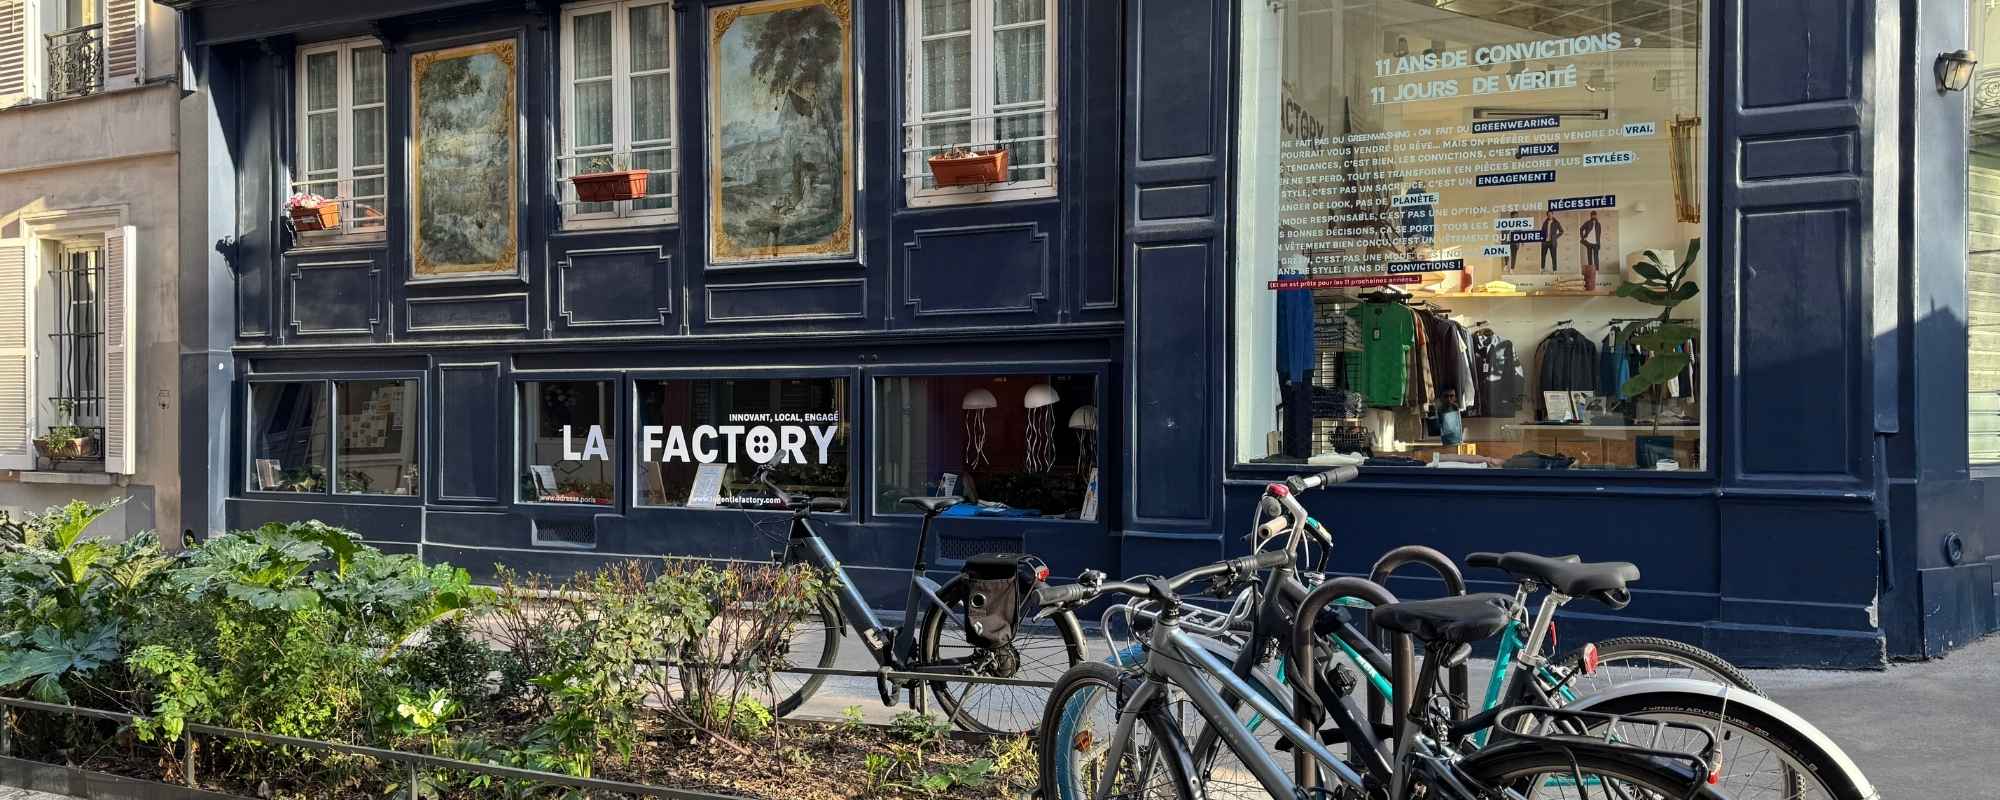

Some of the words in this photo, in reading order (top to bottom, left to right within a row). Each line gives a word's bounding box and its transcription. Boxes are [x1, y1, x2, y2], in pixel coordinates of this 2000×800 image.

[1376, 58, 1391, 77] 11
[1395, 52, 1437, 73] ANS
[1441, 50, 1467, 68] DE
[1475, 31, 1621, 65] CONVICTIONS
[1370, 87, 1384, 104] 11
[1393, 80, 1458, 101] JOURS
[1472, 76, 1499, 94] DE
[1507, 64, 1577, 91] VÉRITÉ
[1281, 149, 1325, 159] POURRAIT
[1327, 147, 1351, 156] VOUS
[1354, 145, 1390, 154] VENDRE
[1393, 144, 1406, 152] DU
[1443, 139, 1468, 149] MAIS
[1471, 138, 1484, 146] ON
[1625, 125, 1654, 134] VRAI.
[1314, 137, 1329, 146] PAS
[1332, 135, 1345, 144] DU
[1456, 124, 1469, 133] DU
[1474, 118, 1558, 132] GREENWEARING.
[1344, 158, 1370, 168] C'EST
[1488, 148, 1518, 157] C'EST
[1521, 145, 1557, 154] MIEUX.
[1312, 187, 1337, 196] C'EST
[1340, 186, 1356, 194] PAS
[1360, 184, 1373, 192] UN
[1478, 172, 1548, 185] ENGAGEMENT
[1347, 171, 1372, 180] TOUT
[1373, 171, 1385, 179] SE
[1282, 217, 1308, 226] MODE
[1408, 209, 1426, 219] PAS
[1429, 208, 1449, 217] UNE
[1550, 196, 1607, 210] NÉCESSITÉ
[1313, 202, 1325, 210] DE
[1355, 198, 1373, 207] PAS
[1375, 197, 1389, 206] DE
[1287, 229, 1323, 238] BONNES
[1396, 225, 1407, 233] SE
[1409, 223, 1440, 233] PORTE
[1496, 220, 1532, 229] JOURS.
[1285, 240, 1331, 250] VÊTEMENT
[1333, 239, 1354, 248] BIEN
[1513, 232, 1544, 241] DURE.
[1316, 255, 1341, 263] C'EST
[1343, 254, 1360, 262] PAS
[1363, 253, 1382, 261] UNE
[1484, 247, 1508, 256] ADN.
[1352, 264, 1371, 273] ANS
[1375, 263, 1388, 272] DE
[1390, 261, 1455, 272] CONVICTIONS
[729, 413, 773, 423] INNOVANT,
[774, 413, 803, 423] LOCAL,
[805, 410, 839, 422] ENGAGÉ
[563, 424, 609, 461] LA
[643, 424, 838, 465] FACTORY
